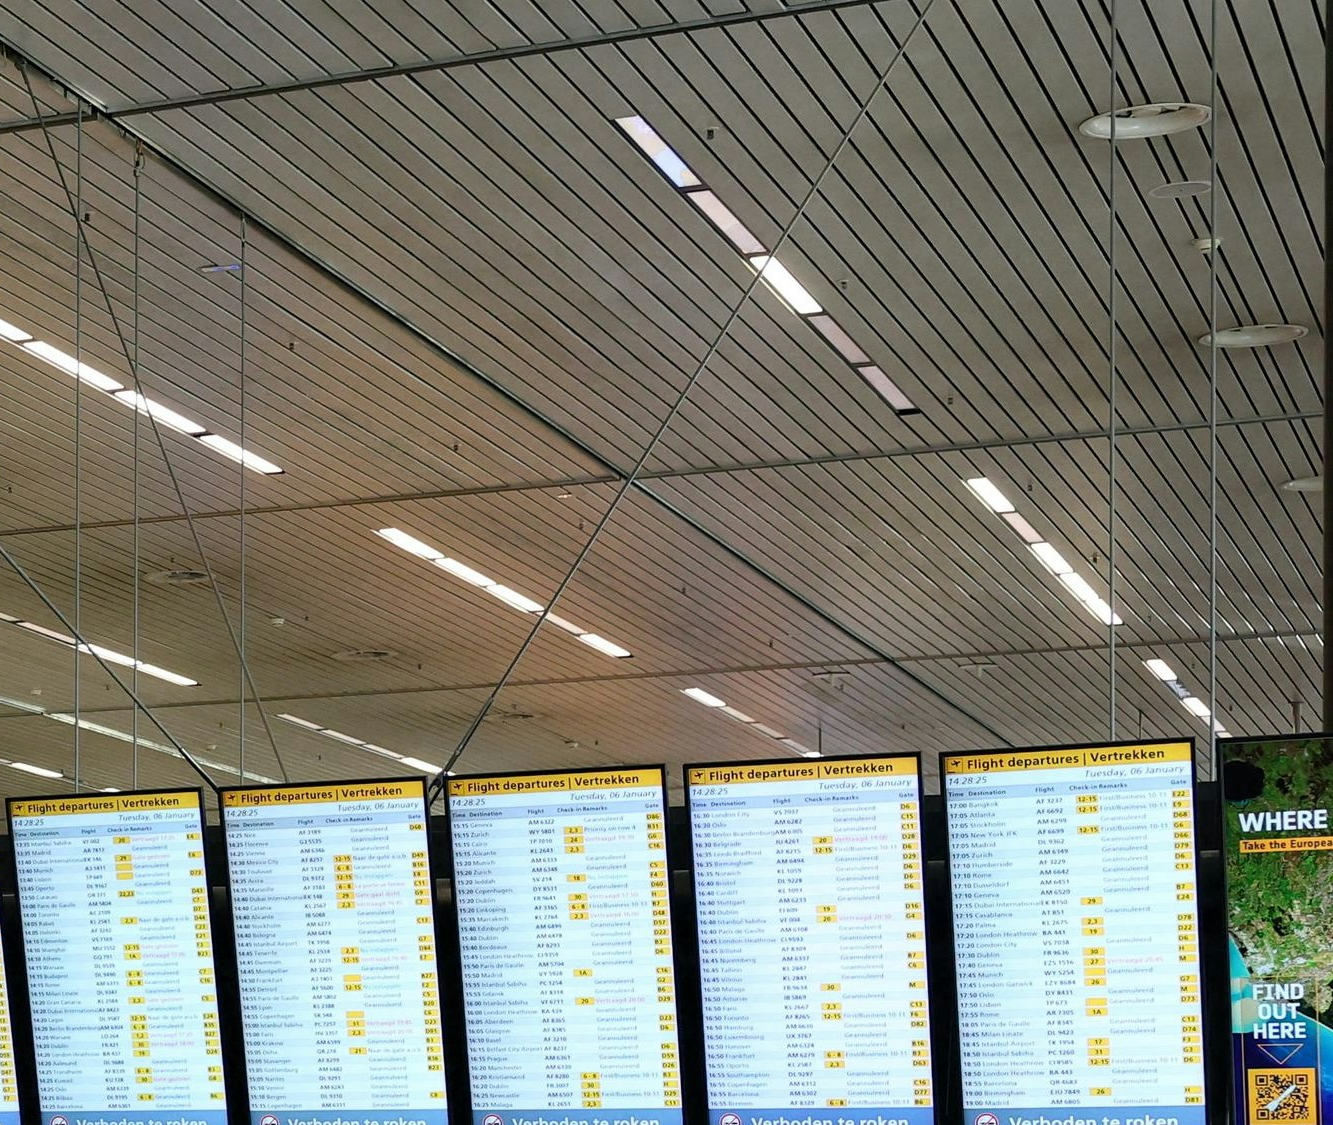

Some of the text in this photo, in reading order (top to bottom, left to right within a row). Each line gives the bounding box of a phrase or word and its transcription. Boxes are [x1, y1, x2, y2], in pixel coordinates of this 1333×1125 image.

[968, 749, 1164, 771] Flight departures Vertrekken
[709, 764, 893, 782] Flight departures Vertrekken
[1085, 768, 1127, 778] Tuesday,
[1130, 766, 1143, 775] 06
[1145, 764, 1184, 776] January
[468, 775, 639, 793] Flight departures Vertrekken
[819, 781, 859, 790] Tuesday,
[862, 780, 873, 788] 06
[874, 779, 911, 789] January
[241, 787, 402, 804] Flight departures Vertrekken
[571, 792, 607, 801] Tuesday,
[622, 790, 657, 800] January
[28, 797, 179, 813] Flight departures Vertrekken
[338, 804, 372, 812] Tuesday,
[386, 801, 419, 810] January
[119, 813, 151, 822] Tuesday,
[165, 811, 195, 820] January
[1238, 809, 1327, 832] WHERE
[1243, 841, 1265, 850] Take
[1290, 840, 1333, 848] Europea
[1253, 984, 1305, 1000] FIND
[1258, 1003, 1299, 1019] OUT
[1253, 1022, 1306, 1039] HERE
